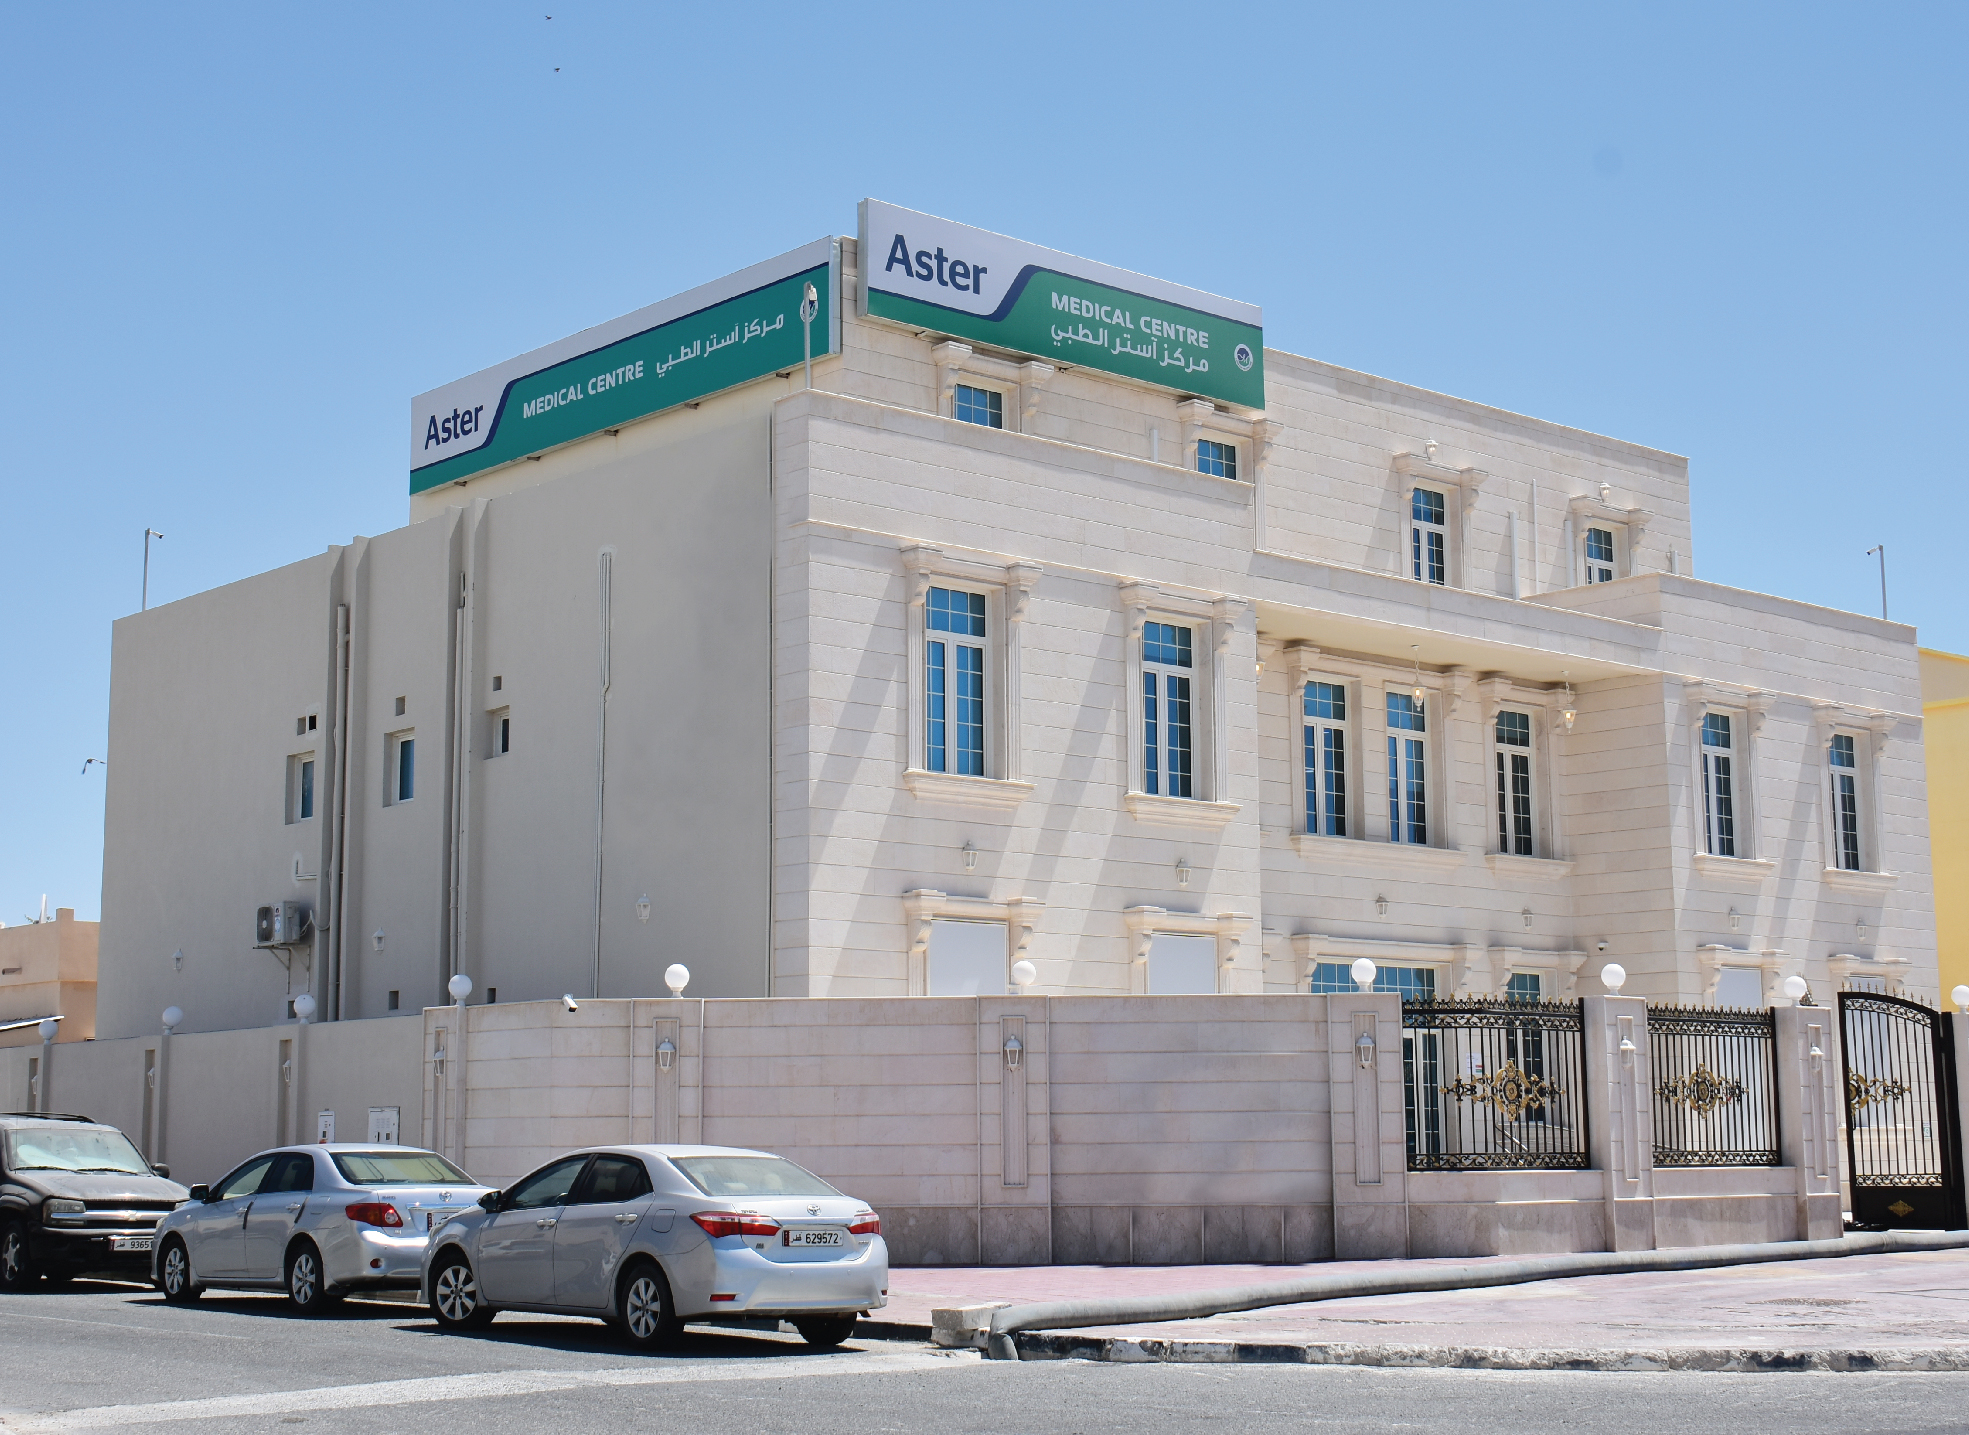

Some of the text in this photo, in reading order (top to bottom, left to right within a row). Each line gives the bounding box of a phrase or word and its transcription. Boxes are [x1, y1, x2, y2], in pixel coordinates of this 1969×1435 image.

[885, 233, 988, 295] Aster
[742, 313, 784, 344] مركز
[1050, 323, 1109, 347] الطبي
[1051, 291, 1209, 349] MEDICAL CENTRE
[656, 340, 701, 379] الطبي
[1110, 333, 1158, 360] آستر
[1159, 343, 1209, 373] مركز
[523, 360, 644, 419] MEDICAL CENTRE
[424, 404, 484, 451] Aster
[130, 1240, 153, 1249] 9365
[805, 1232, 839, 1245] 629572
